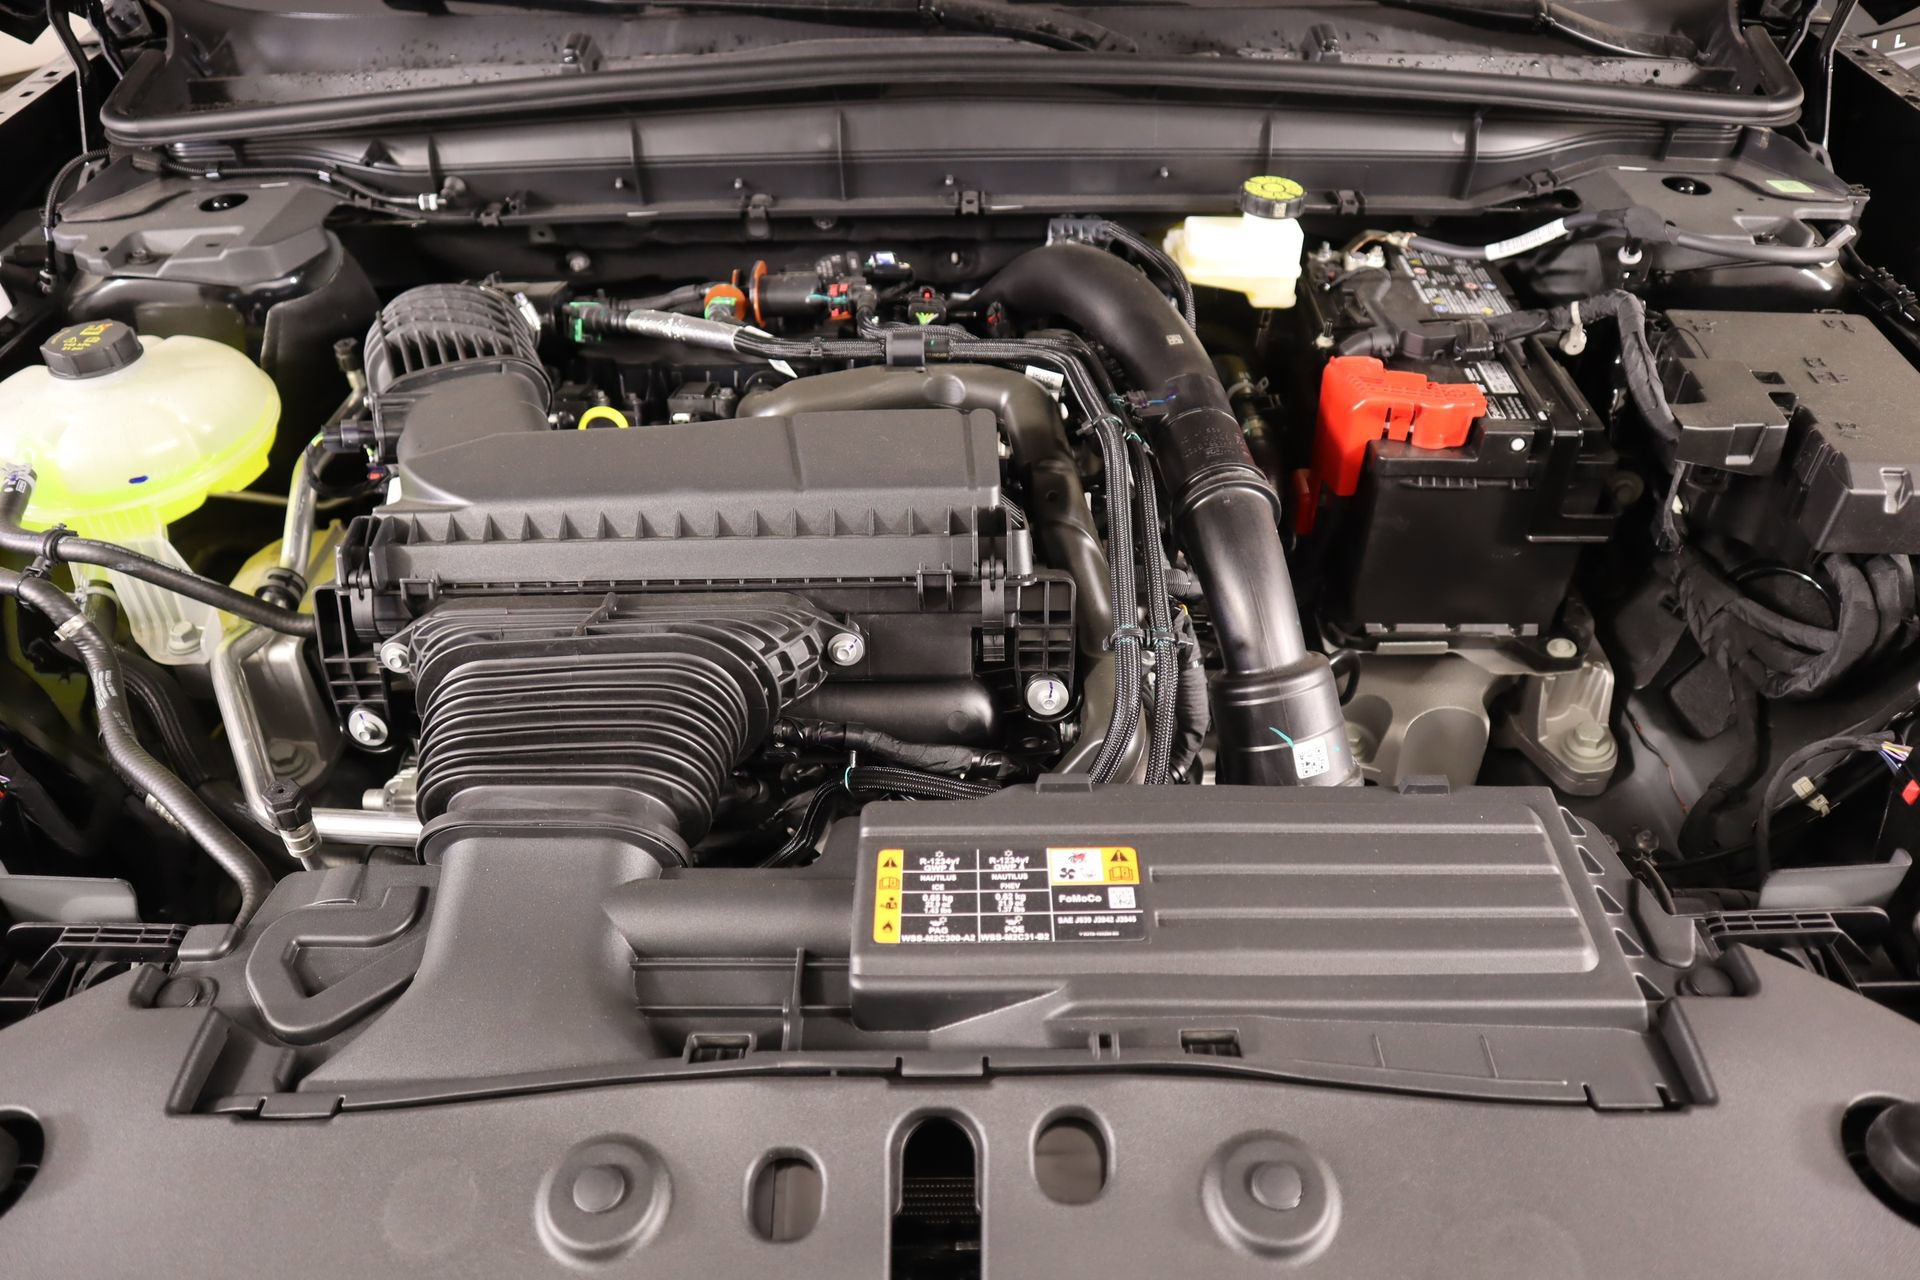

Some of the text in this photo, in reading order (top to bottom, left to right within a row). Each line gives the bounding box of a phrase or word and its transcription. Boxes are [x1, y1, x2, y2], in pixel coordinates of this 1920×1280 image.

[919, 857, 960, 867] R-1234yf
[988, 855, 1030, 866] R-1234yf
[919, 874, 957, 882] NAUTILUS
[991, 873, 1029, 881] NAUTILUS
[931, 883, 945, 891] ICE
[942, 894, 954, 903] kg
[1014, 893, 1027, 902] kg
[1058, 894, 1103, 903] FoMoCo
[1004, 925, 1025, 933] POE
